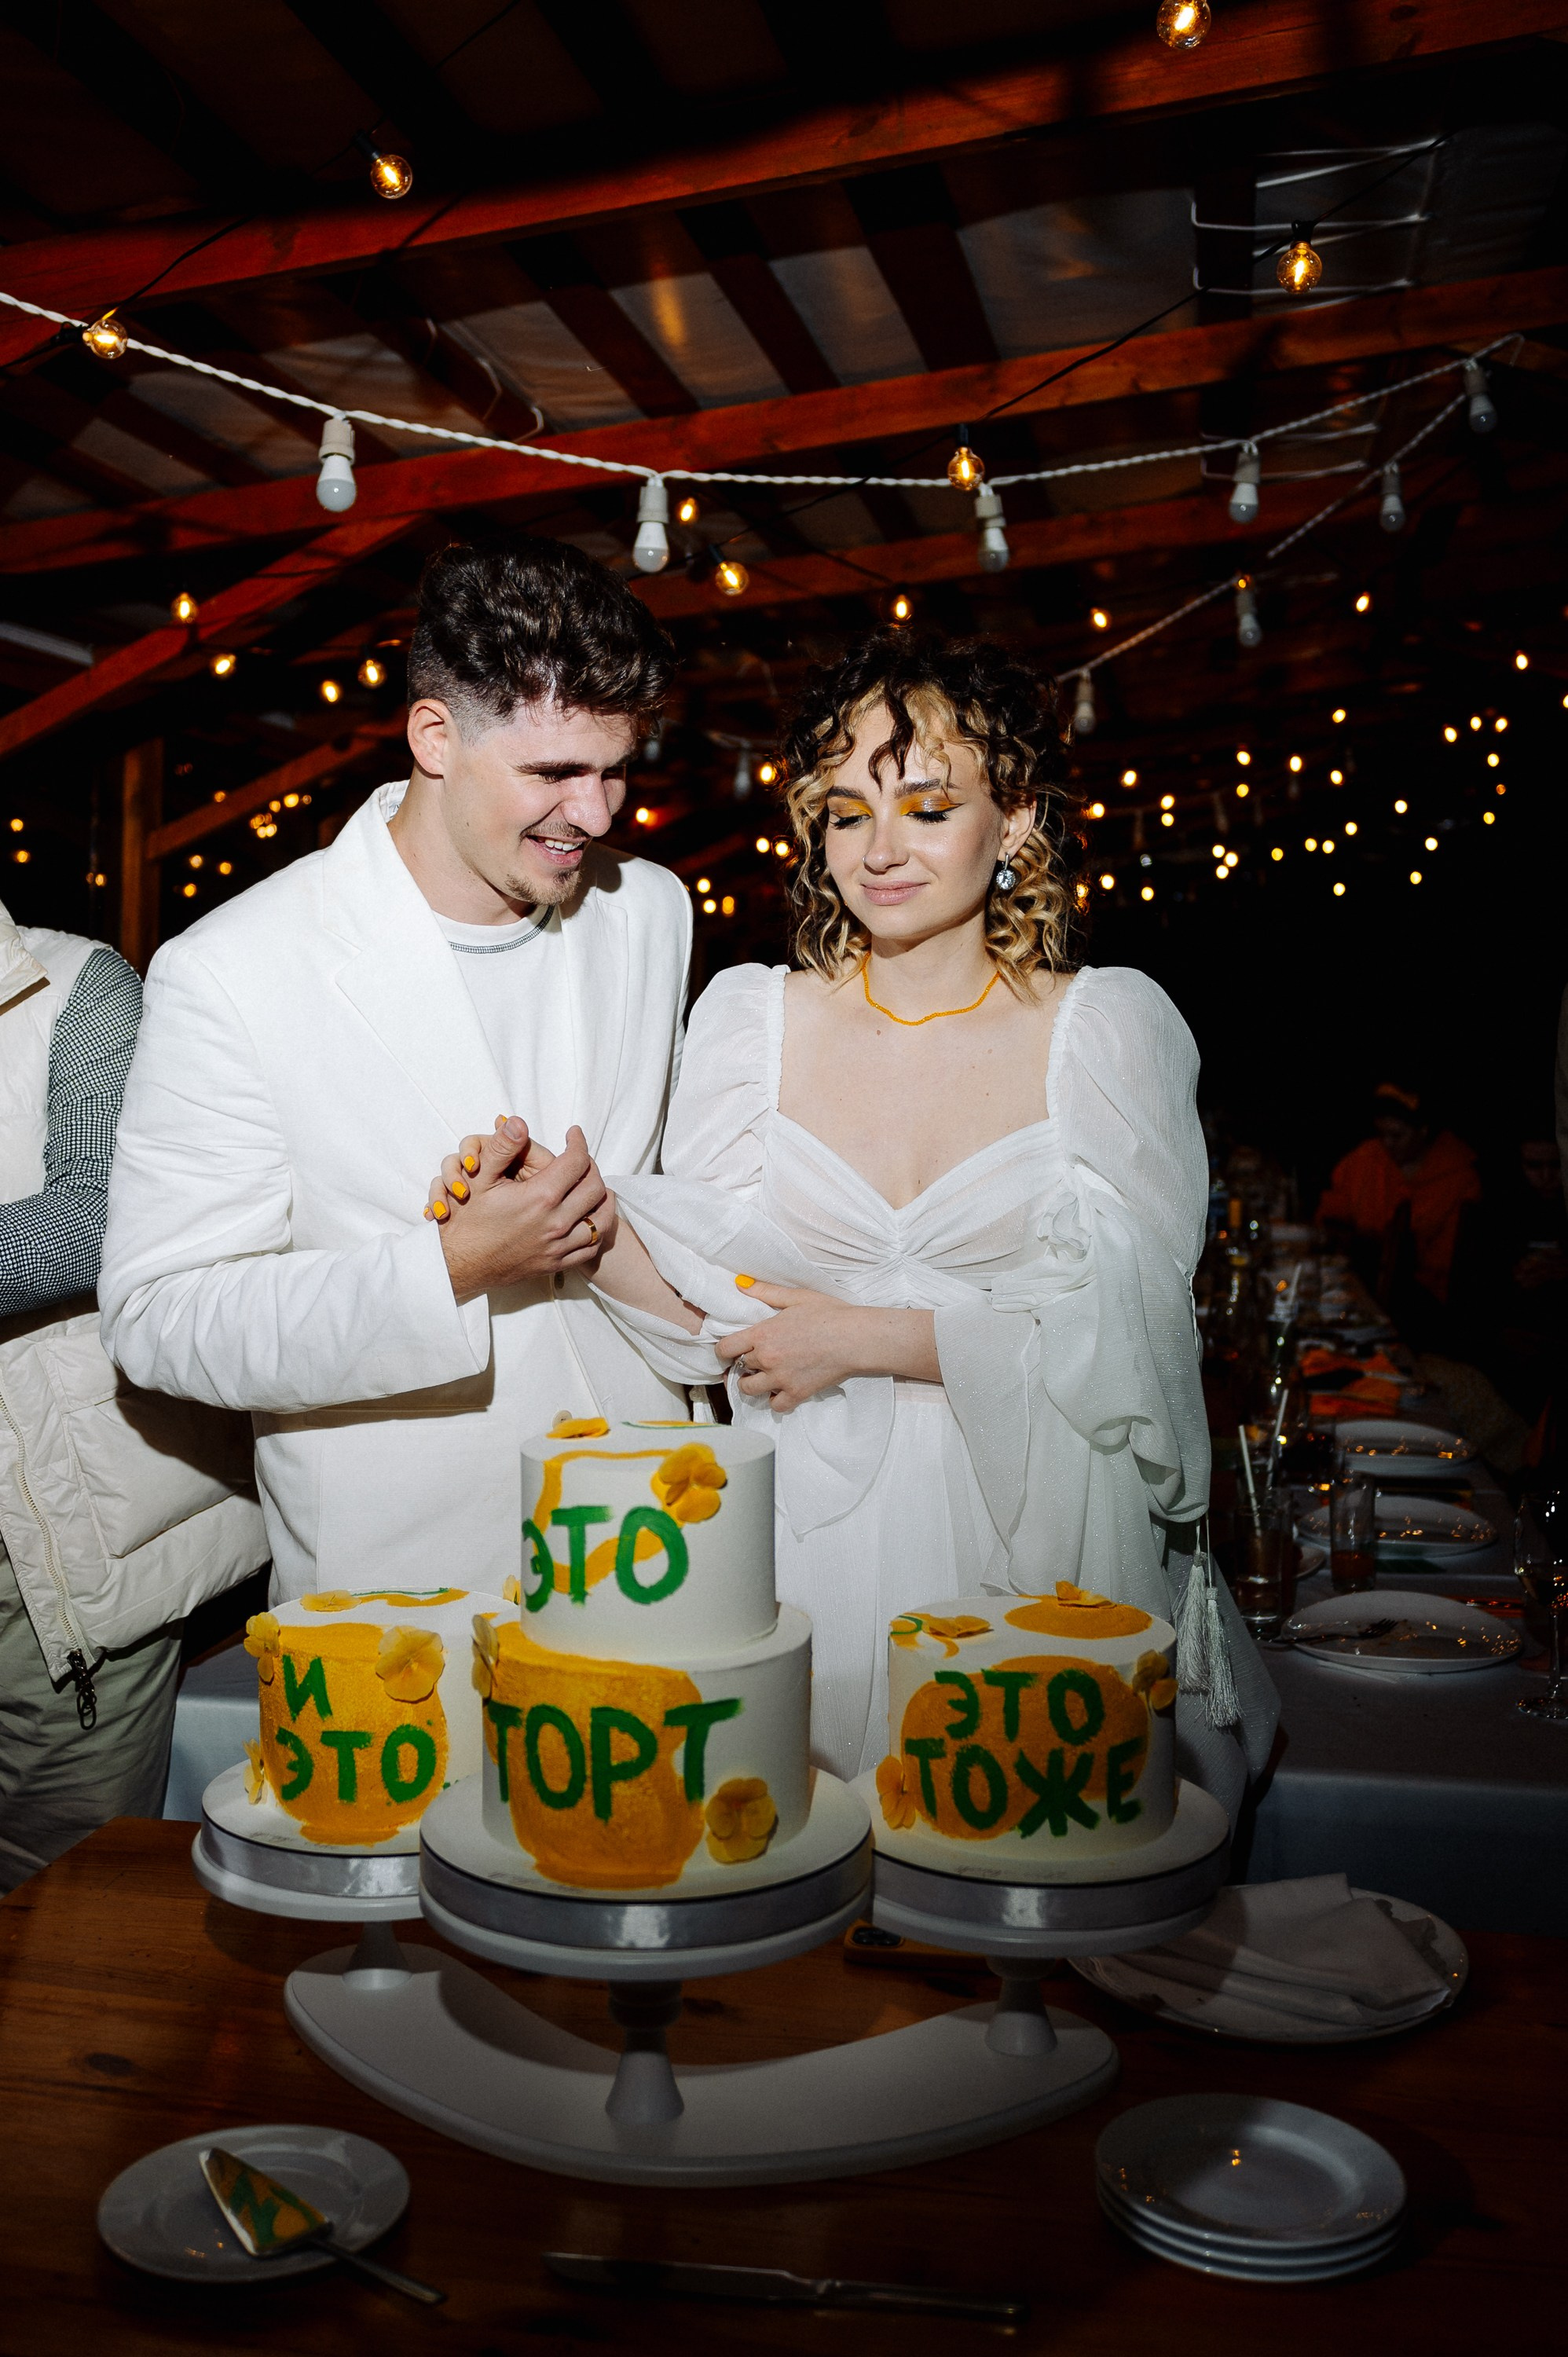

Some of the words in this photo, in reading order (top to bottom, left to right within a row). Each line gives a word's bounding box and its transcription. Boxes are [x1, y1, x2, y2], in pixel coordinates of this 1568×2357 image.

[521, 1505, 689, 1613] ЭТО
[282, 1655, 333, 1721] И
[934, 1668, 1105, 1746] ЭТО
[276, 1724, 437, 1805] ЭТО
[487, 1698, 745, 1825] ТОРТ
[904, 1736, 1146, 1838] ТОЖЕ
